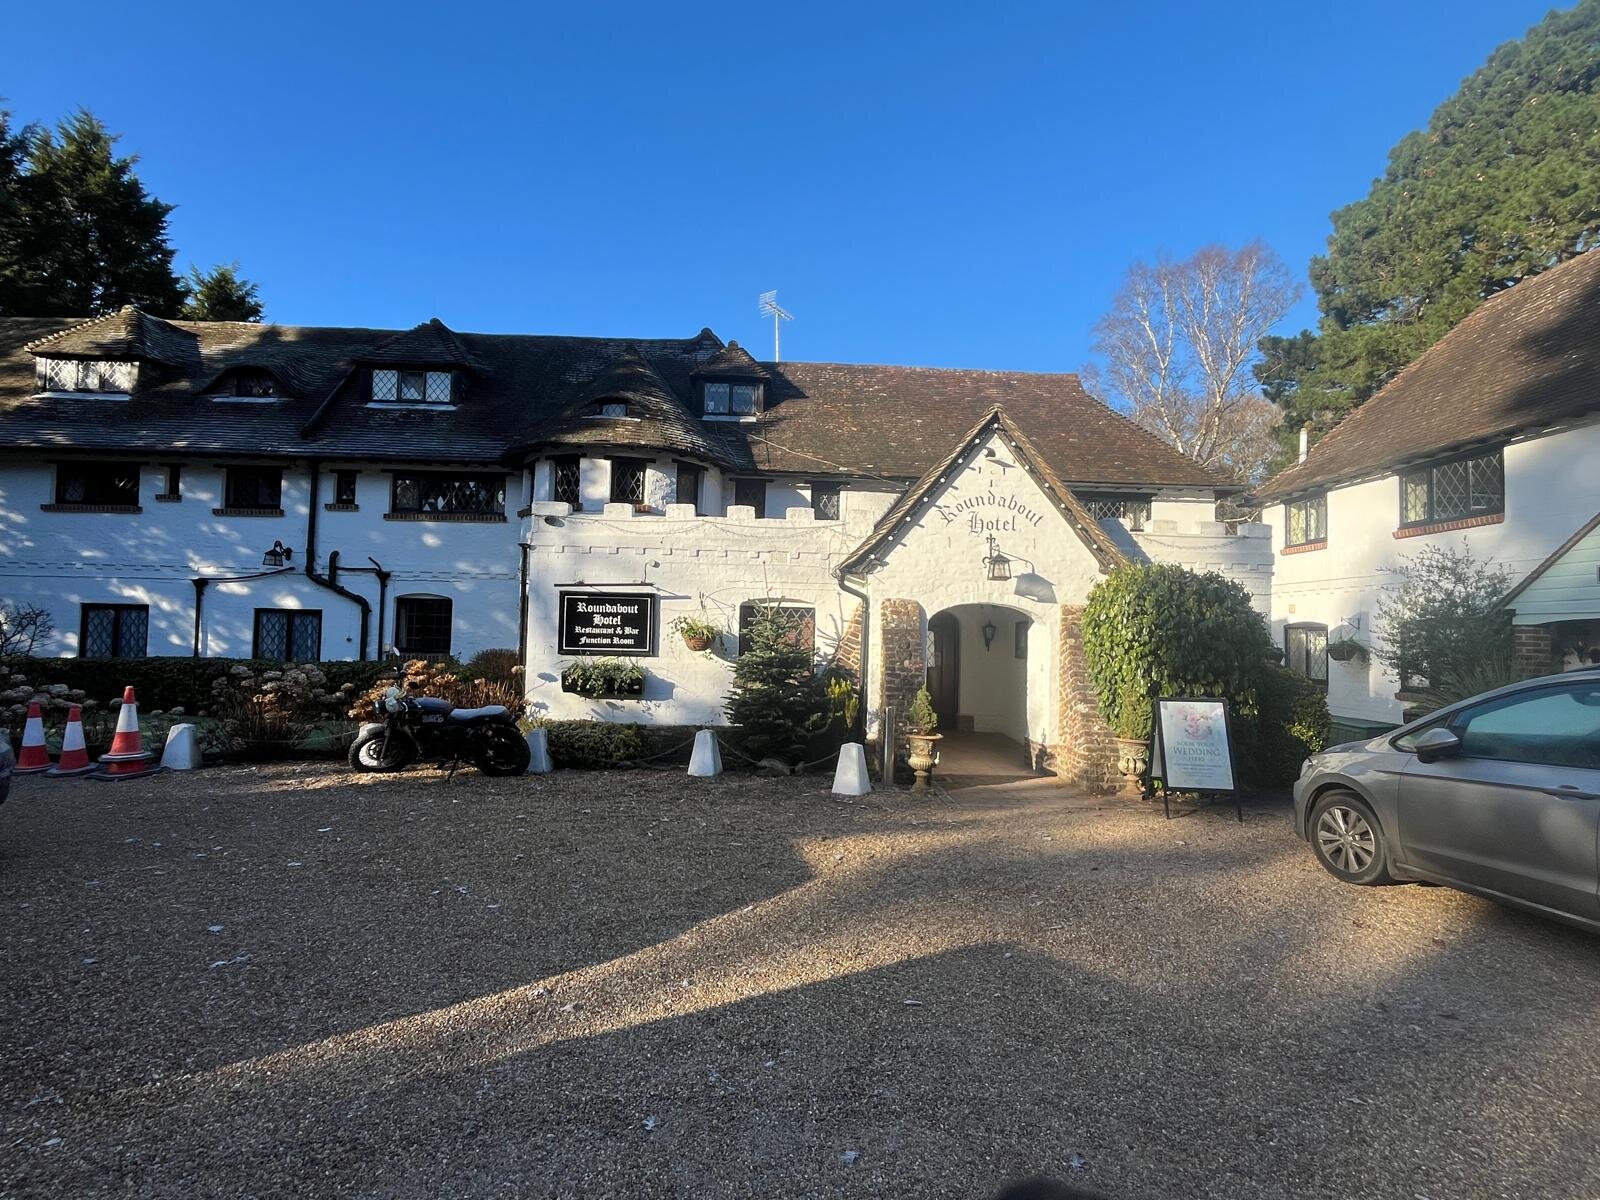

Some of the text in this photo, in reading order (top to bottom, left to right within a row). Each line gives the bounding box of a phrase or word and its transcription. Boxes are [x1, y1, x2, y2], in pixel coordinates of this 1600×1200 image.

[936, 490, 1044, 527] Roundabout
[968, 511, 1016, 536] Hotel
[576, 602, 638, 613] Roundabout
[593, 614, 621, 626] Hotel
[575, 626, 639, 635] Restaurant & Bar
[579, 637, 634, 645] Function Room
[1173, 747, 1221, 756] WEDDING
